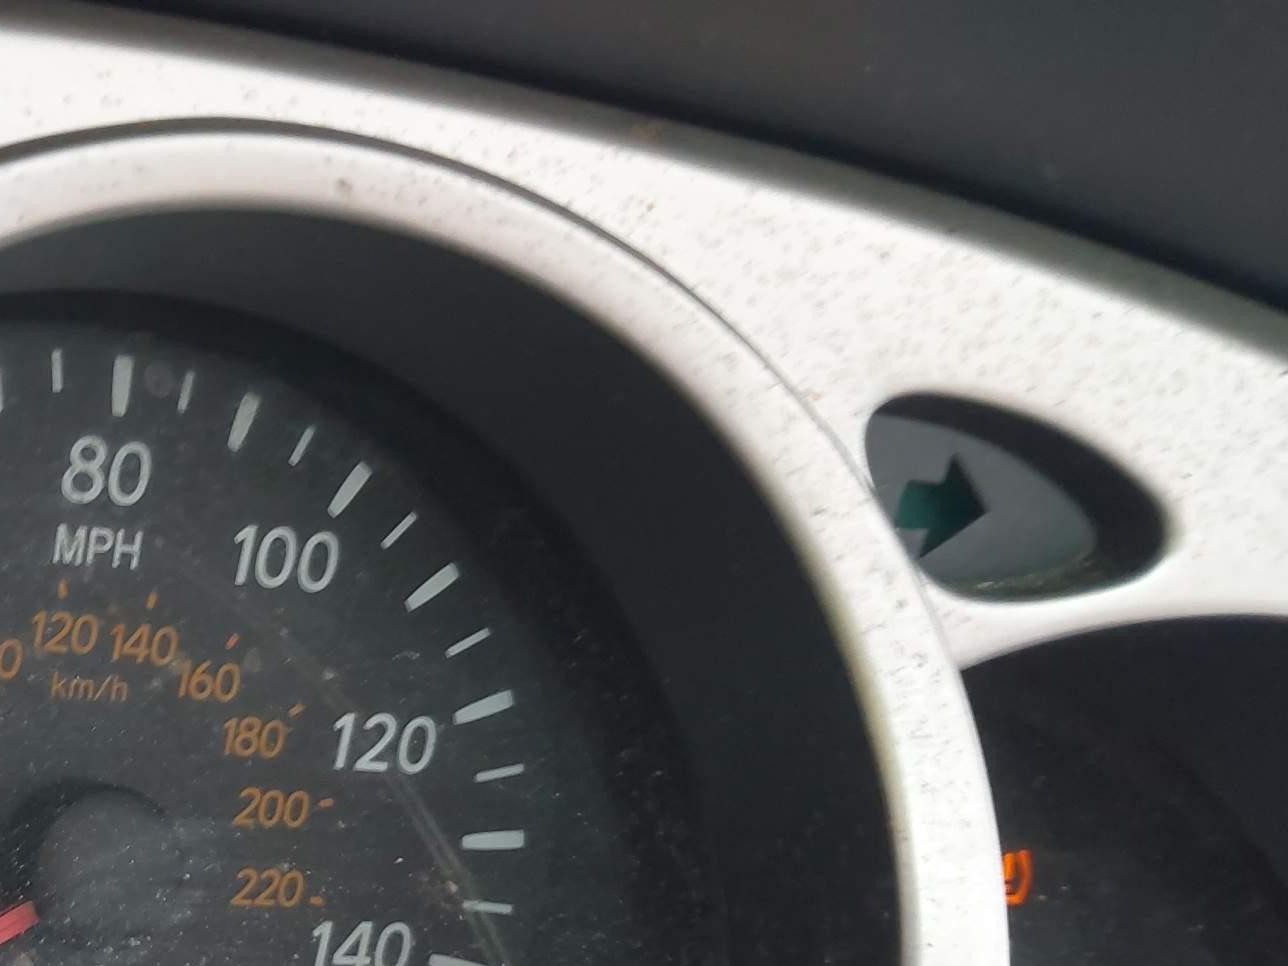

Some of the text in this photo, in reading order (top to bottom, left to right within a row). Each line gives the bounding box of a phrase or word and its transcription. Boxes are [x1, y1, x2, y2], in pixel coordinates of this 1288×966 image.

[60, 435, 152, 506] 80
[52, 523, 143, 570] MPH
[234, 524, 340, 593] 100
[31, 610, 99, 656] 120
[110, 624, 180, 666] 140
[49, 671, 129, 703] km/h
[177, 661, 241, 702] 160
[222, 717, 286, 759] 180
[333, 712, 437, 775] 120
[232, 787, 310, 829] 200
[230, 868, 306, 909] 220
